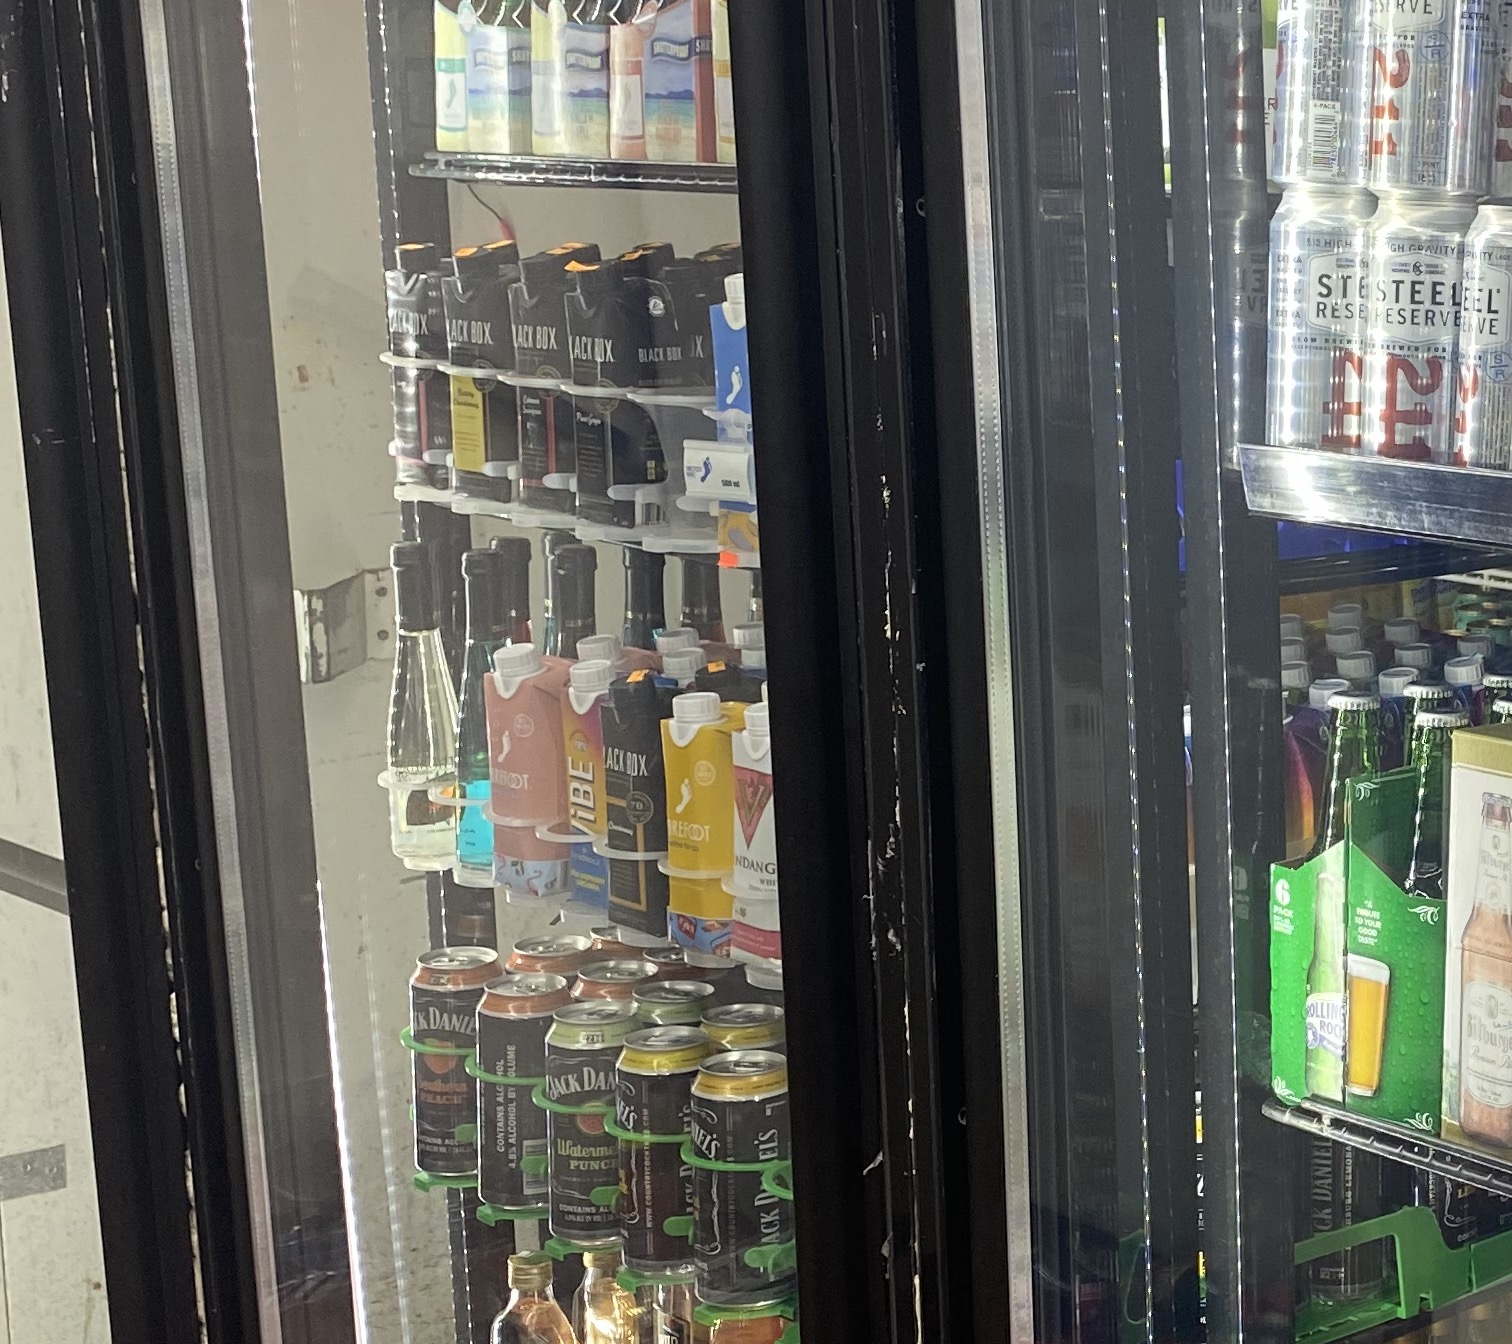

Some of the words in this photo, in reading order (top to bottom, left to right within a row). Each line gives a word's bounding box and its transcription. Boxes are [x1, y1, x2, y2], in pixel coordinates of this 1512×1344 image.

[1376, 280, 1463, 306] STEEL
[471, 320, 493, 344] BOX
[536, 325, 558, 350] BOX
[594, 338, 615, 363] BOX
[638, 347, 663, 364] BLACK
[627, 752, 649, 777] BOX
[1275, 878, 1290, 906] 6
[1273, 905, 1294, 918] PACK
[1365, 918, 1382, 930] YOUR
[1358, 926, 1378, 937] GOOD
[550, 1073, 580, 1101] JACK
[496, 1105, 505, 1153] CONTAINS
[508, 1105, 518, 1150] ALCOHOL
